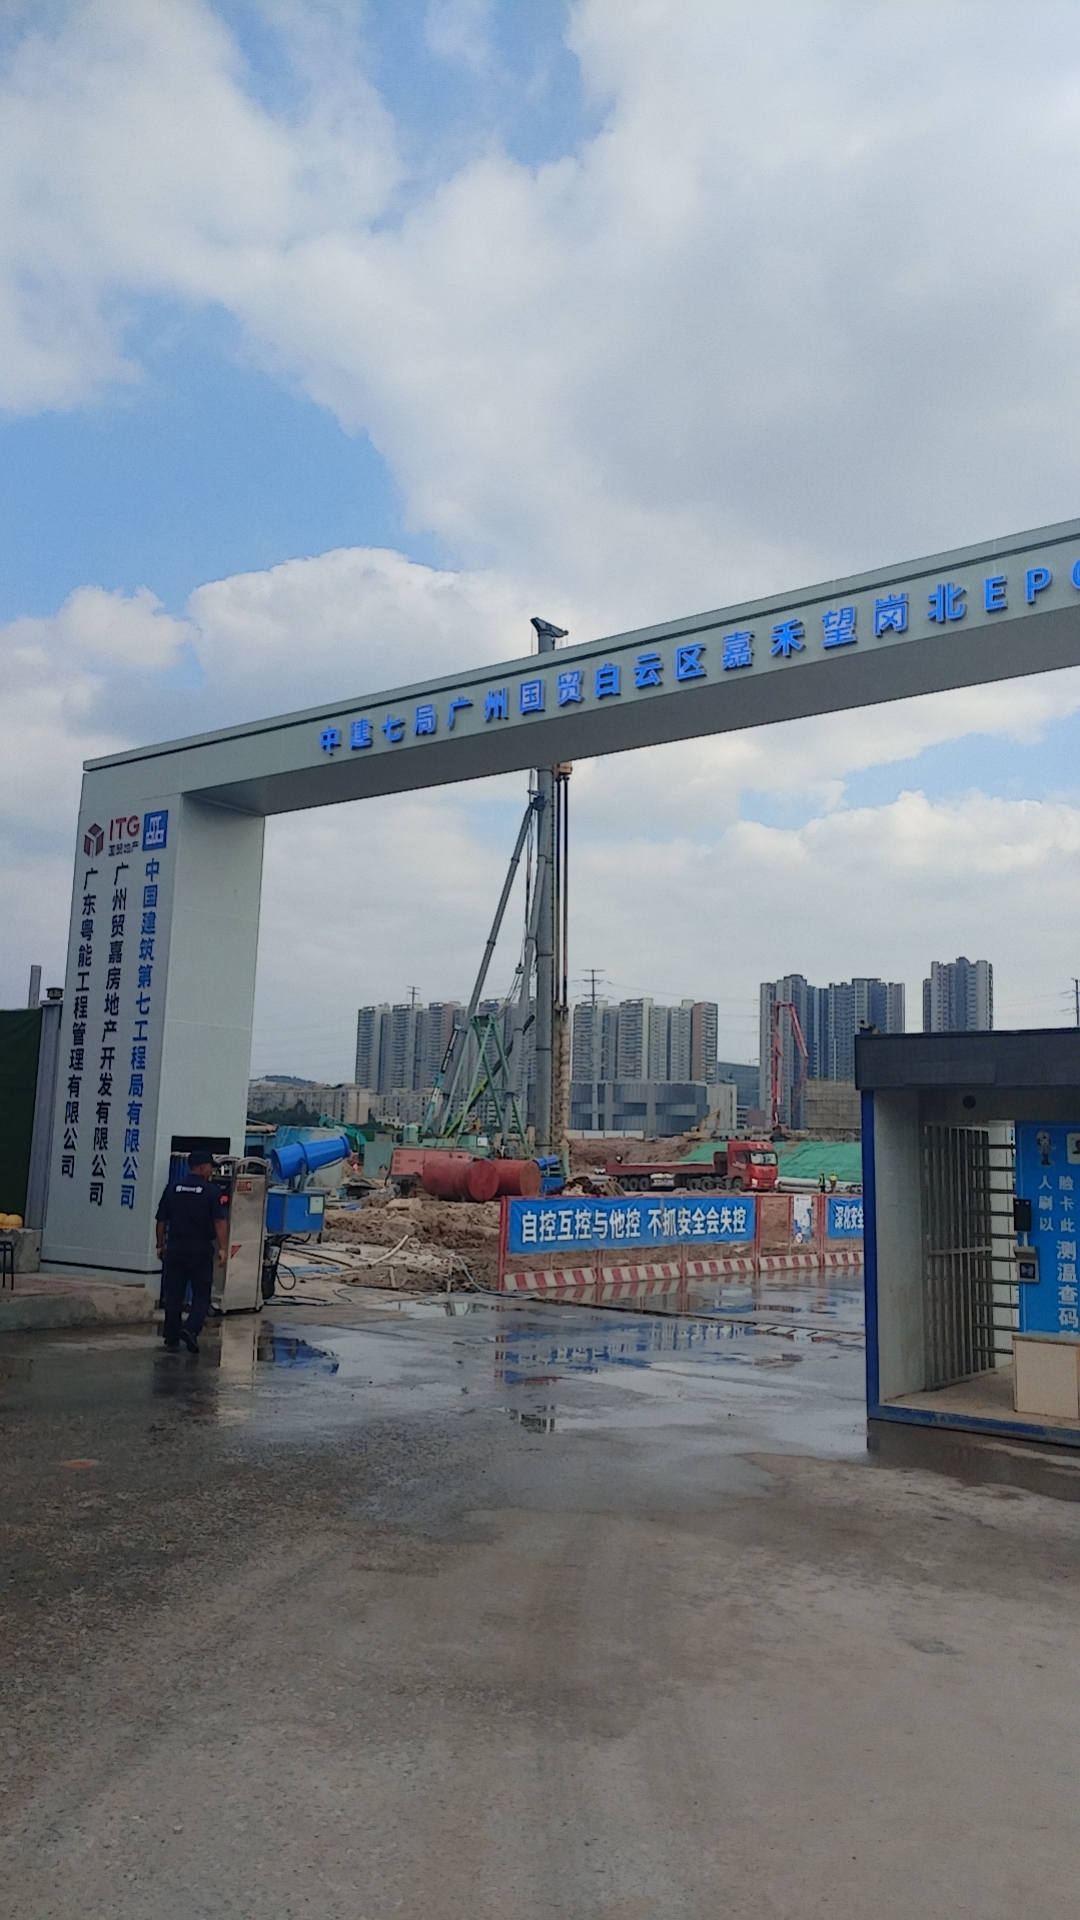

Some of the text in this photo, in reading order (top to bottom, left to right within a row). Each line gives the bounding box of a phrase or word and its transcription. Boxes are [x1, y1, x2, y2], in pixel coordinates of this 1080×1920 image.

[109, 815, 140, 842] ITG
[61, 867, 99, 1179] 广东粤能工程管理有限公司
[89, 862, 129, 1207] 广州贸嘉房地产开发有限公司
[120, 857, 160, 1210] 中国建筑第七工程局有限公司
[522, 1206, 747, 1244] 自控互控与他控 不抓安全会失控
